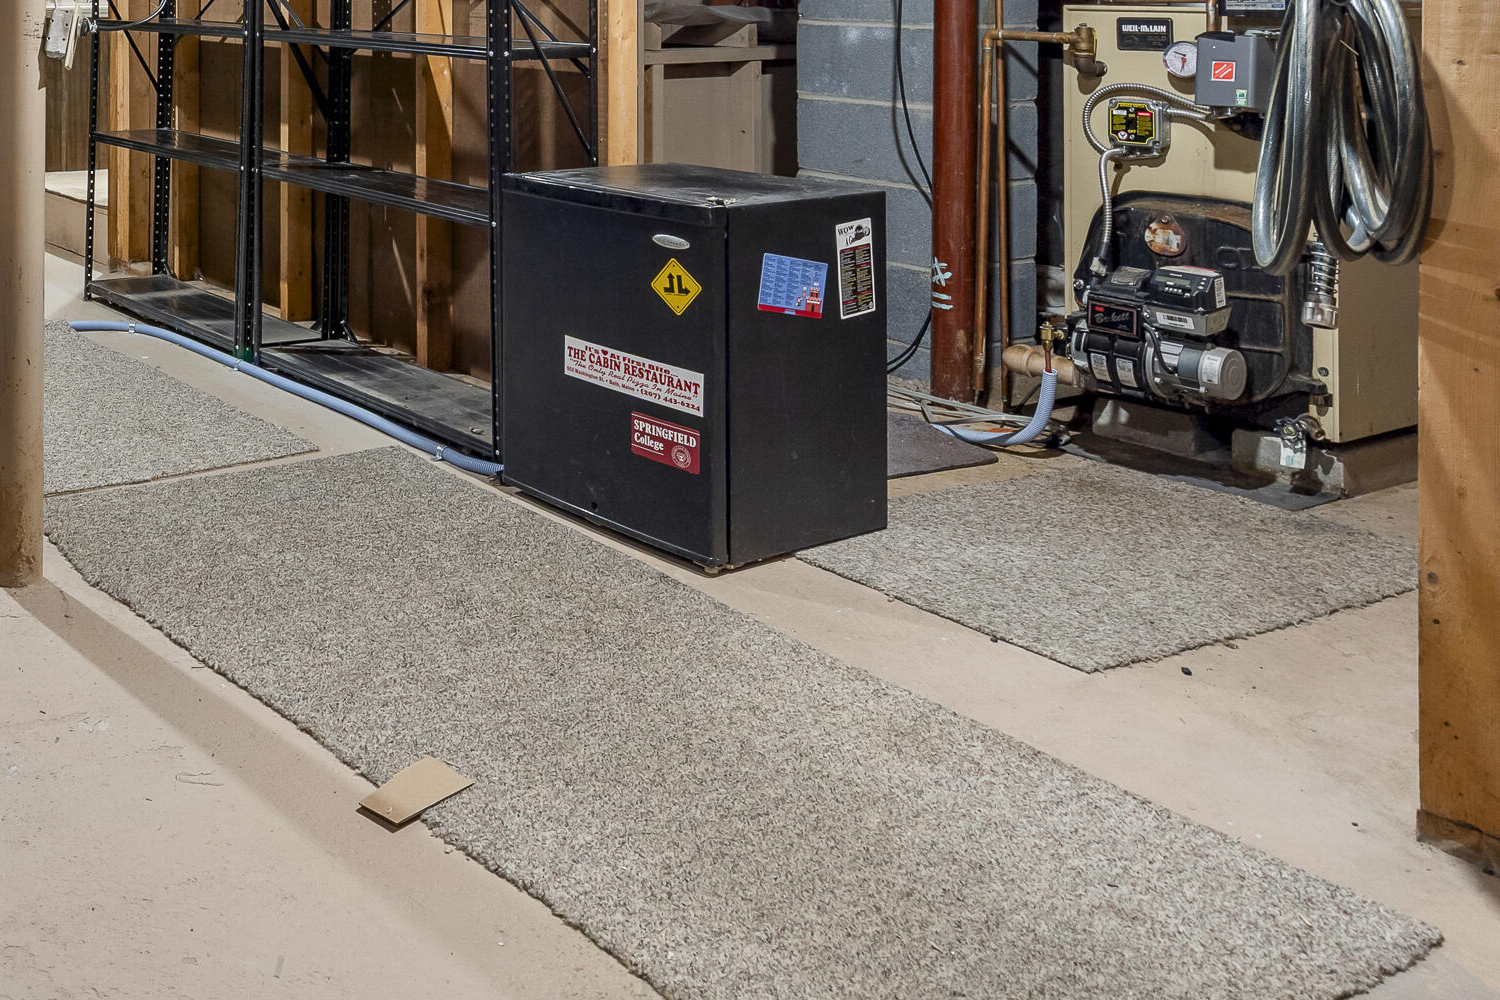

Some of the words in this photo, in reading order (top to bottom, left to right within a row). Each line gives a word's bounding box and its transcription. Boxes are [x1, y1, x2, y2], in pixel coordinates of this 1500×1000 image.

[567, 345, 587, 361] THE
[589, 353, 621, 372] CABIN
[624, 362, 700, 395] RESTAURANT
[640, 388, 661, 400] (207)
[634, 419, 697, 448] SPRINGFIELD
[634, 432, 664, 451] College
